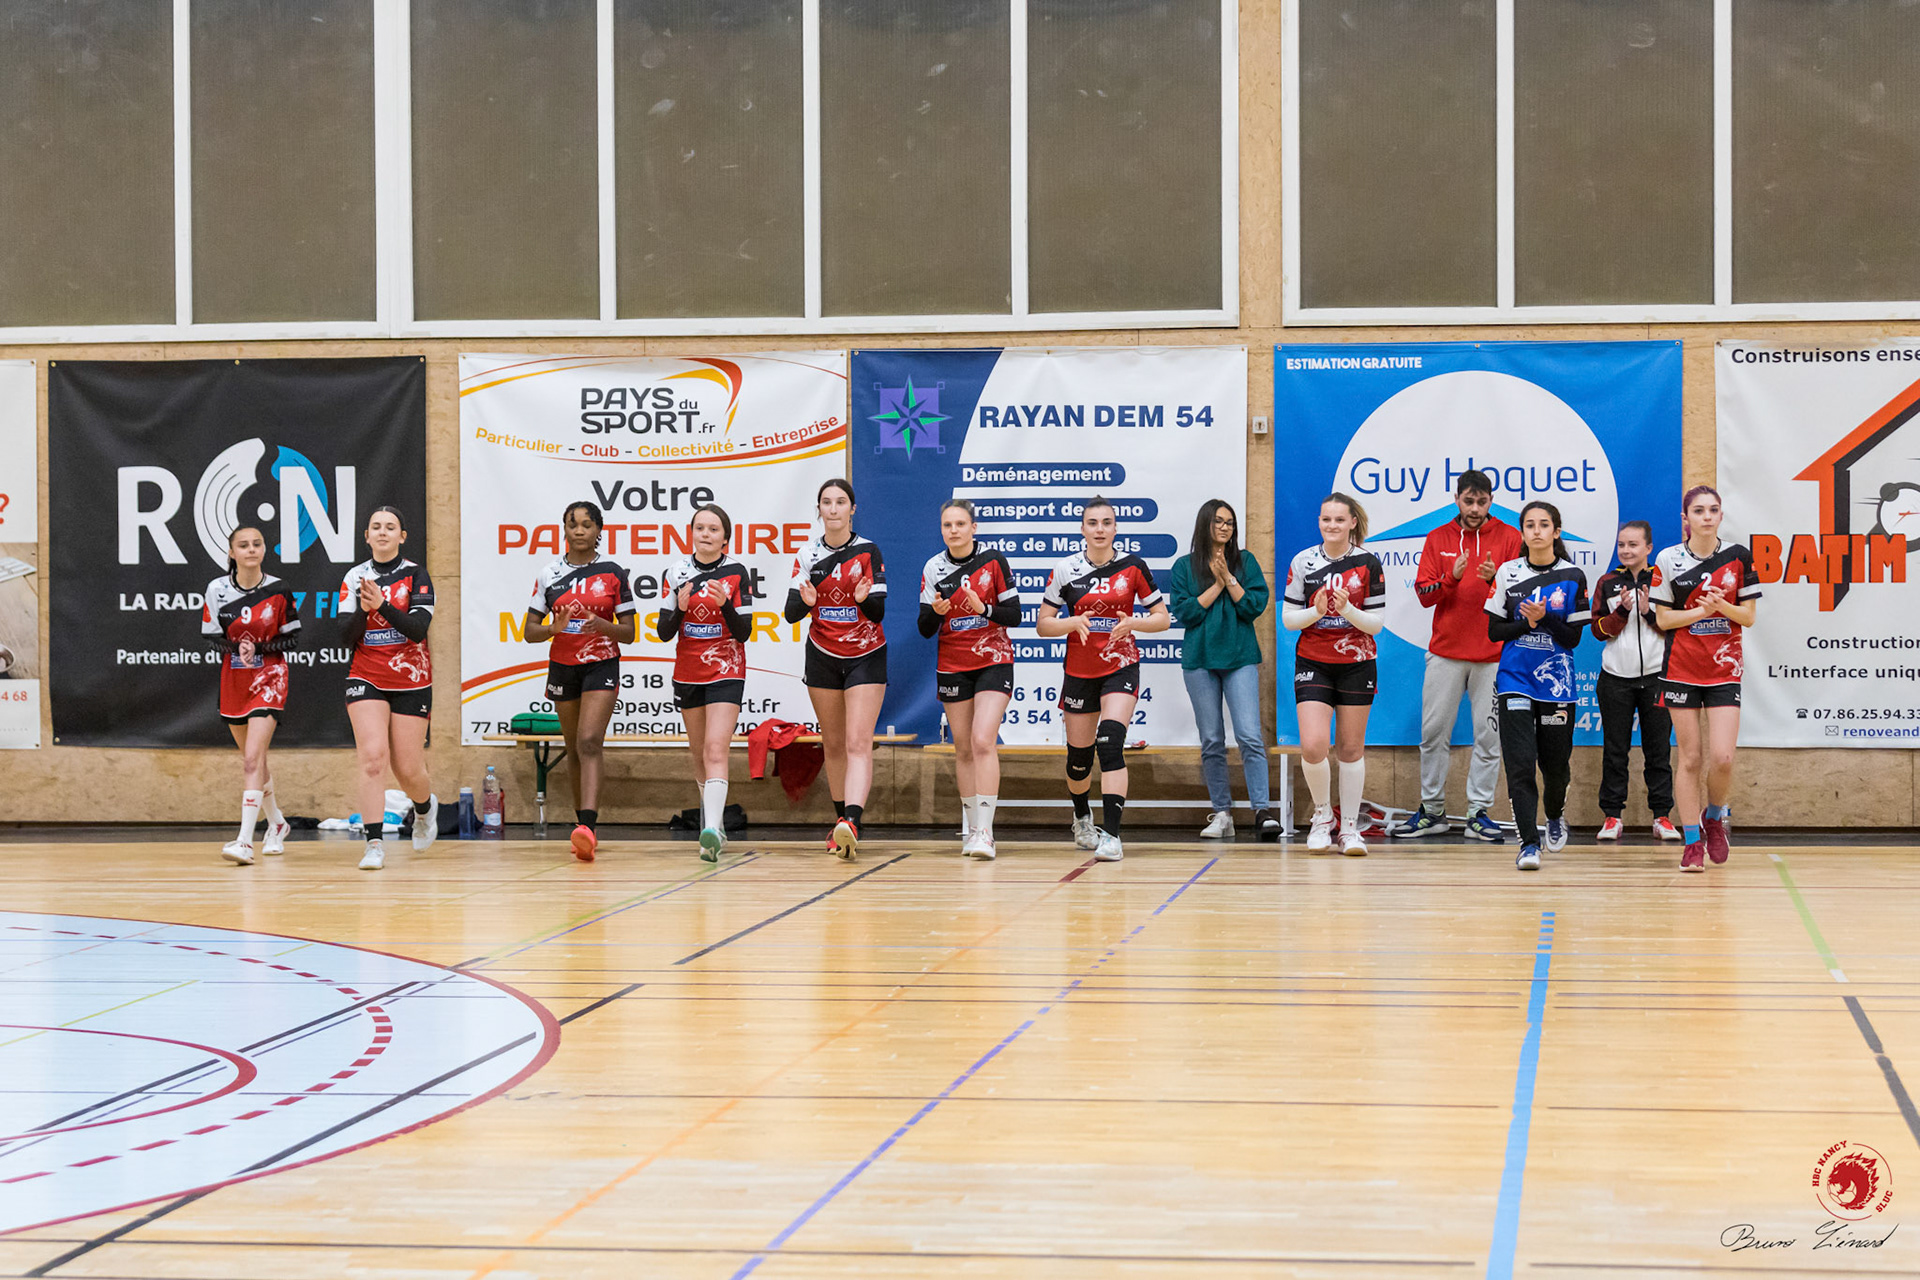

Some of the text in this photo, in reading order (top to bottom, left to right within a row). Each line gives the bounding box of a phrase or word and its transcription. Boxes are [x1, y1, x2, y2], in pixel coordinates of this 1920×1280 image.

[1286, 357, 1422, 370] ESTIMATION GRATUITE
[1731, 347, 1871, 363] Construisons
[580, 387, 698, 410] PAYS du
[979, 405, 1214, 428] RAYAN DEM 54
[475, 427, 563, 454] Particulier
[581, 444, 619, 457] Club
[638, 438, 734, 457] Collectivité
[752, 416, 839, 449] Entreprise
[962, 466, 1112, 484] Déménagement
[1350, 457, 1431, 502] Guy
[591, 480, 714, 511] Votre
[972, 502, 1056, 520] ransport
[1113, 504, 1144, 517] ano
[498, 523, 812, 555] PATENIRE
[1022, 537, 1046, 551] de
[1052, 537, 1141, 552] Matels
[1750, 534, 1907, 583] BATIM
[831, 562, 842, 581] 4
[569, 578, 587, 594] 11
[698, 580, 709, 598] 3
[960, 574, 972, 591] 6
[1089, 577, 1111, 594] 25
[1323, 572, 1343, 590] 10
[1701, 572, 1713, 591] 2
[119, 593, 149, 611] LA
[154, 592, 206, 611] RAD
[1531, 585, 1542, 604] 1
[240, 605, 252, 624] 9
[117, 648, 200, 665] Partenaire
[320, 648, 353, 664] SLU
[641, 674, 664, 689] 18
[1768, 665, 1920, 681] L'interface uniq
[12, 691, 28, 701] 68
[1032, 686, 1057, 702] 16
[1027, 709, 1051, 724] 54
[471, 721, 491, 734] 77
